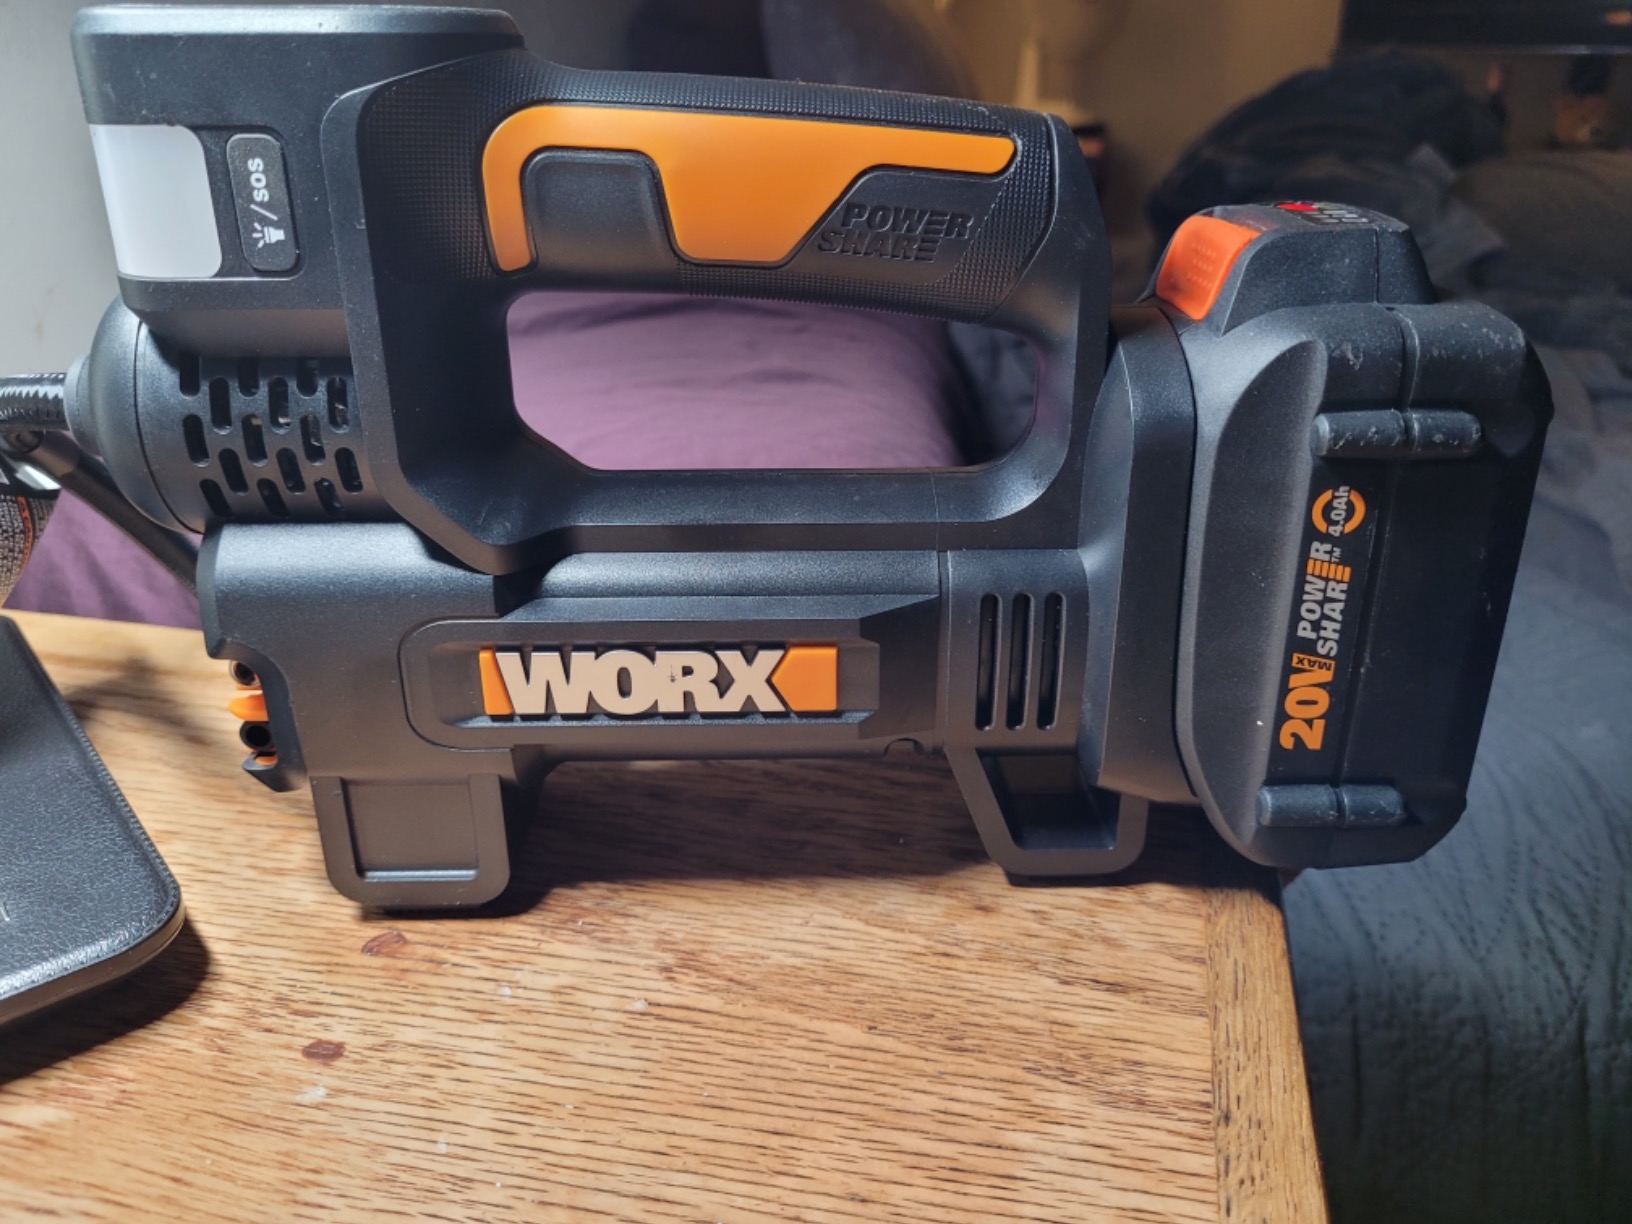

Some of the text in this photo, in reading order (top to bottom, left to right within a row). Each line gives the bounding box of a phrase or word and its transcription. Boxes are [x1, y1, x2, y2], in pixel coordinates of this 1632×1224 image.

[817, 230, 941, 263] SHARE
[840, 202, 973, 239] POWER
[1328, 485, 1349, 537] 4.0Ah
[1296, 541, 1332, 639] POWER
[1317, 566, 1352, 657] SHARE
[495, 650, 786, 714] WORX
[1295, 655, 1333, 672] MAX
[1279, 653, 1335, 750] 20V
